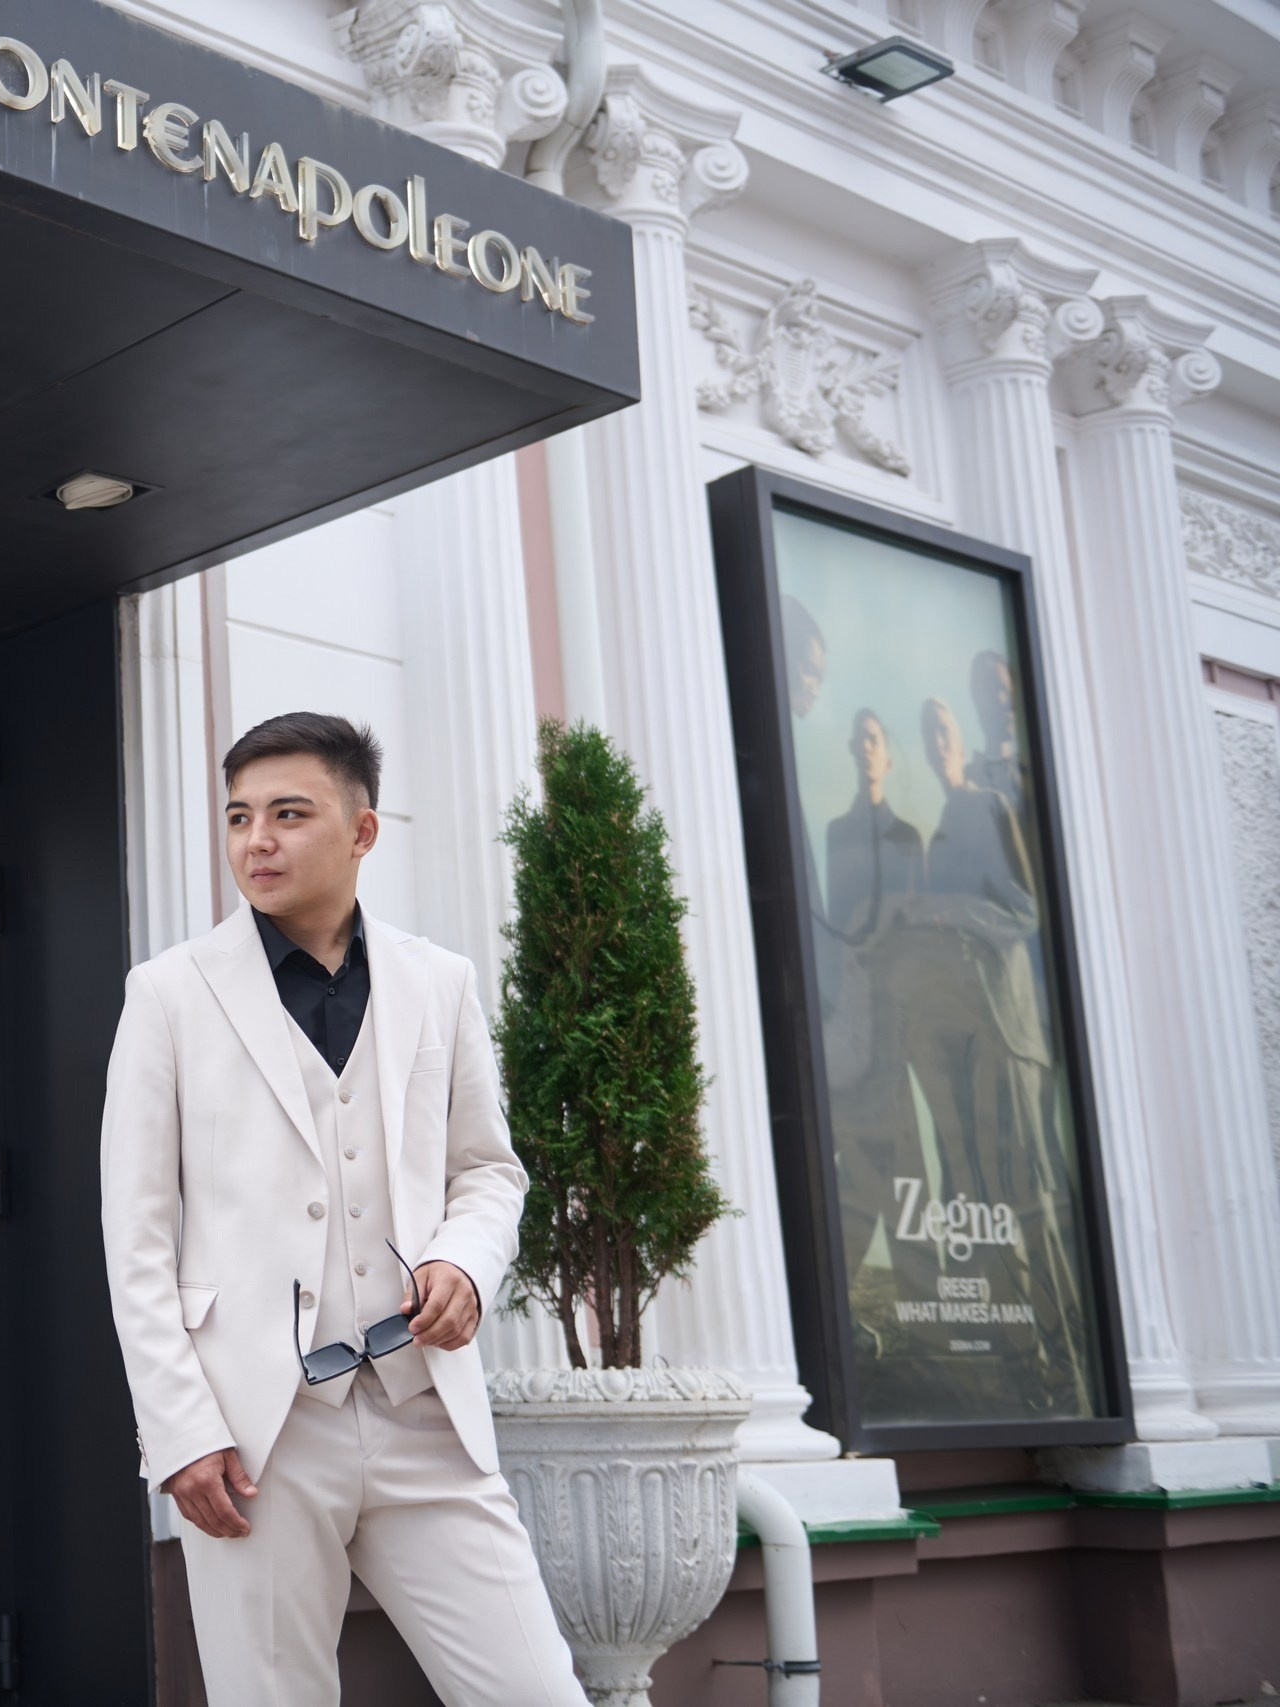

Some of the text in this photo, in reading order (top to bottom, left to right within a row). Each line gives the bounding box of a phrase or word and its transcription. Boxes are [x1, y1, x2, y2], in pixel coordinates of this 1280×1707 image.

[894, 1177, 1017, 1262] Zegna
[895, 1301, 1035, 1324] WHAT MAKES A MAN
